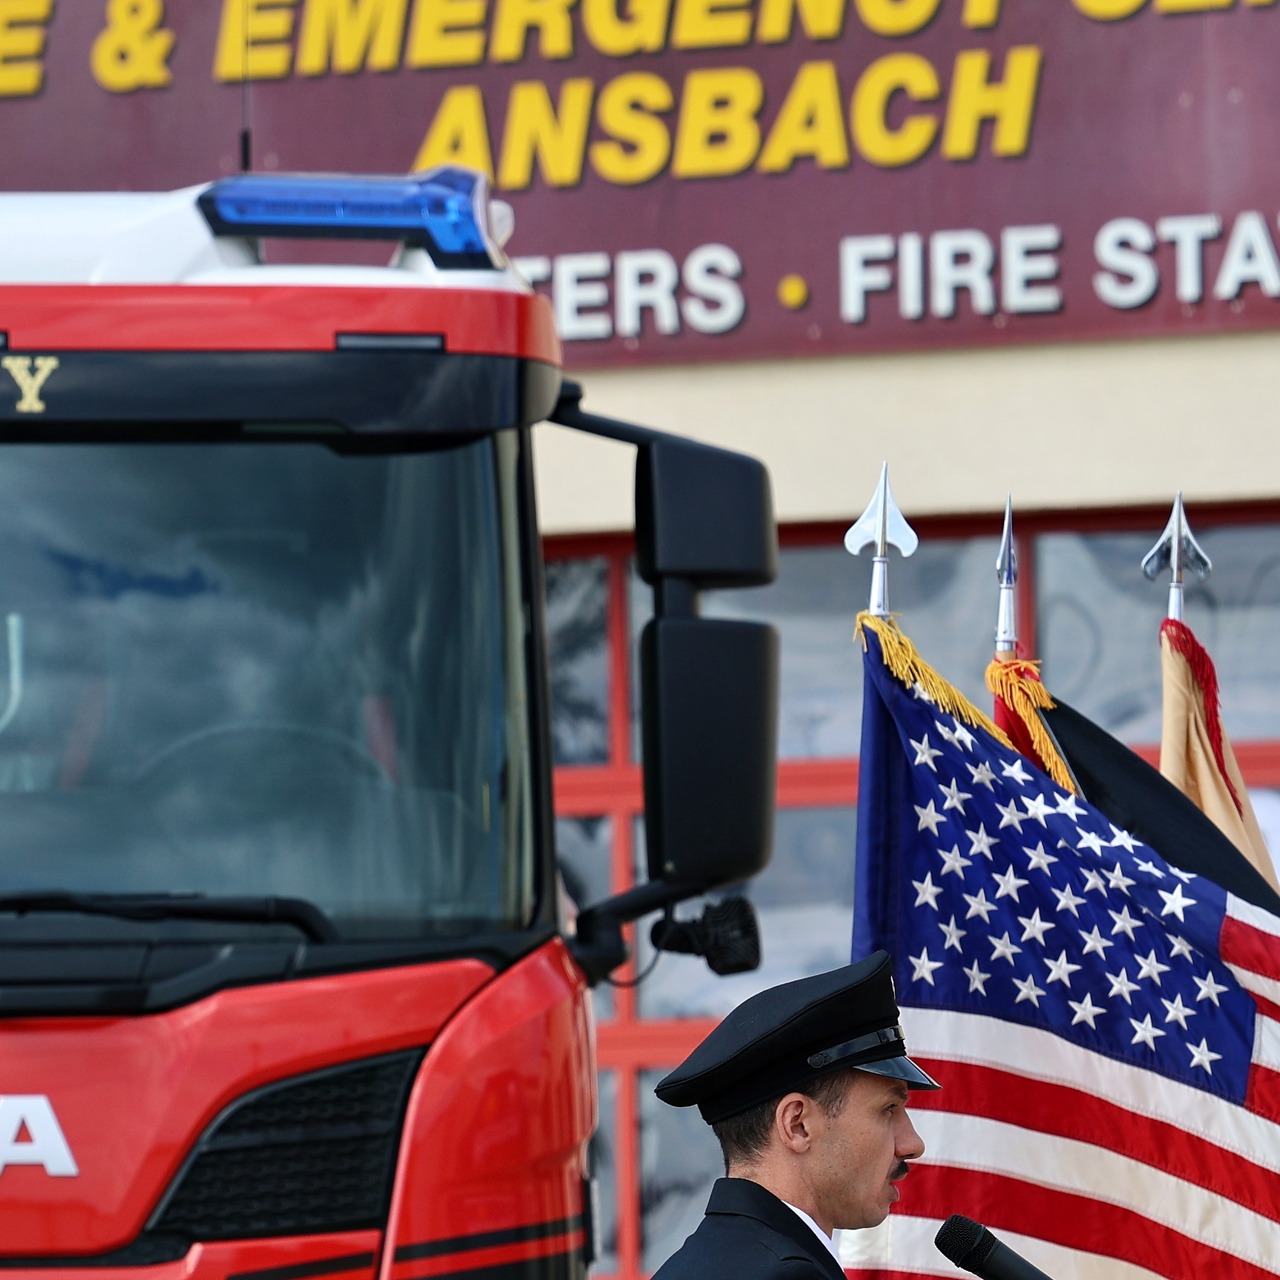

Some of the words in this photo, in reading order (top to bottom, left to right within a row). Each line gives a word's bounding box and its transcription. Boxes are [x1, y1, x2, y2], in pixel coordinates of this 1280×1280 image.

[90, 0, 174, 90] &
[213, 0, 1000, 81] EMERG
[410, 47, 1042, 190] ANSBACH
[840, 224, 1061, 322] FIRE
